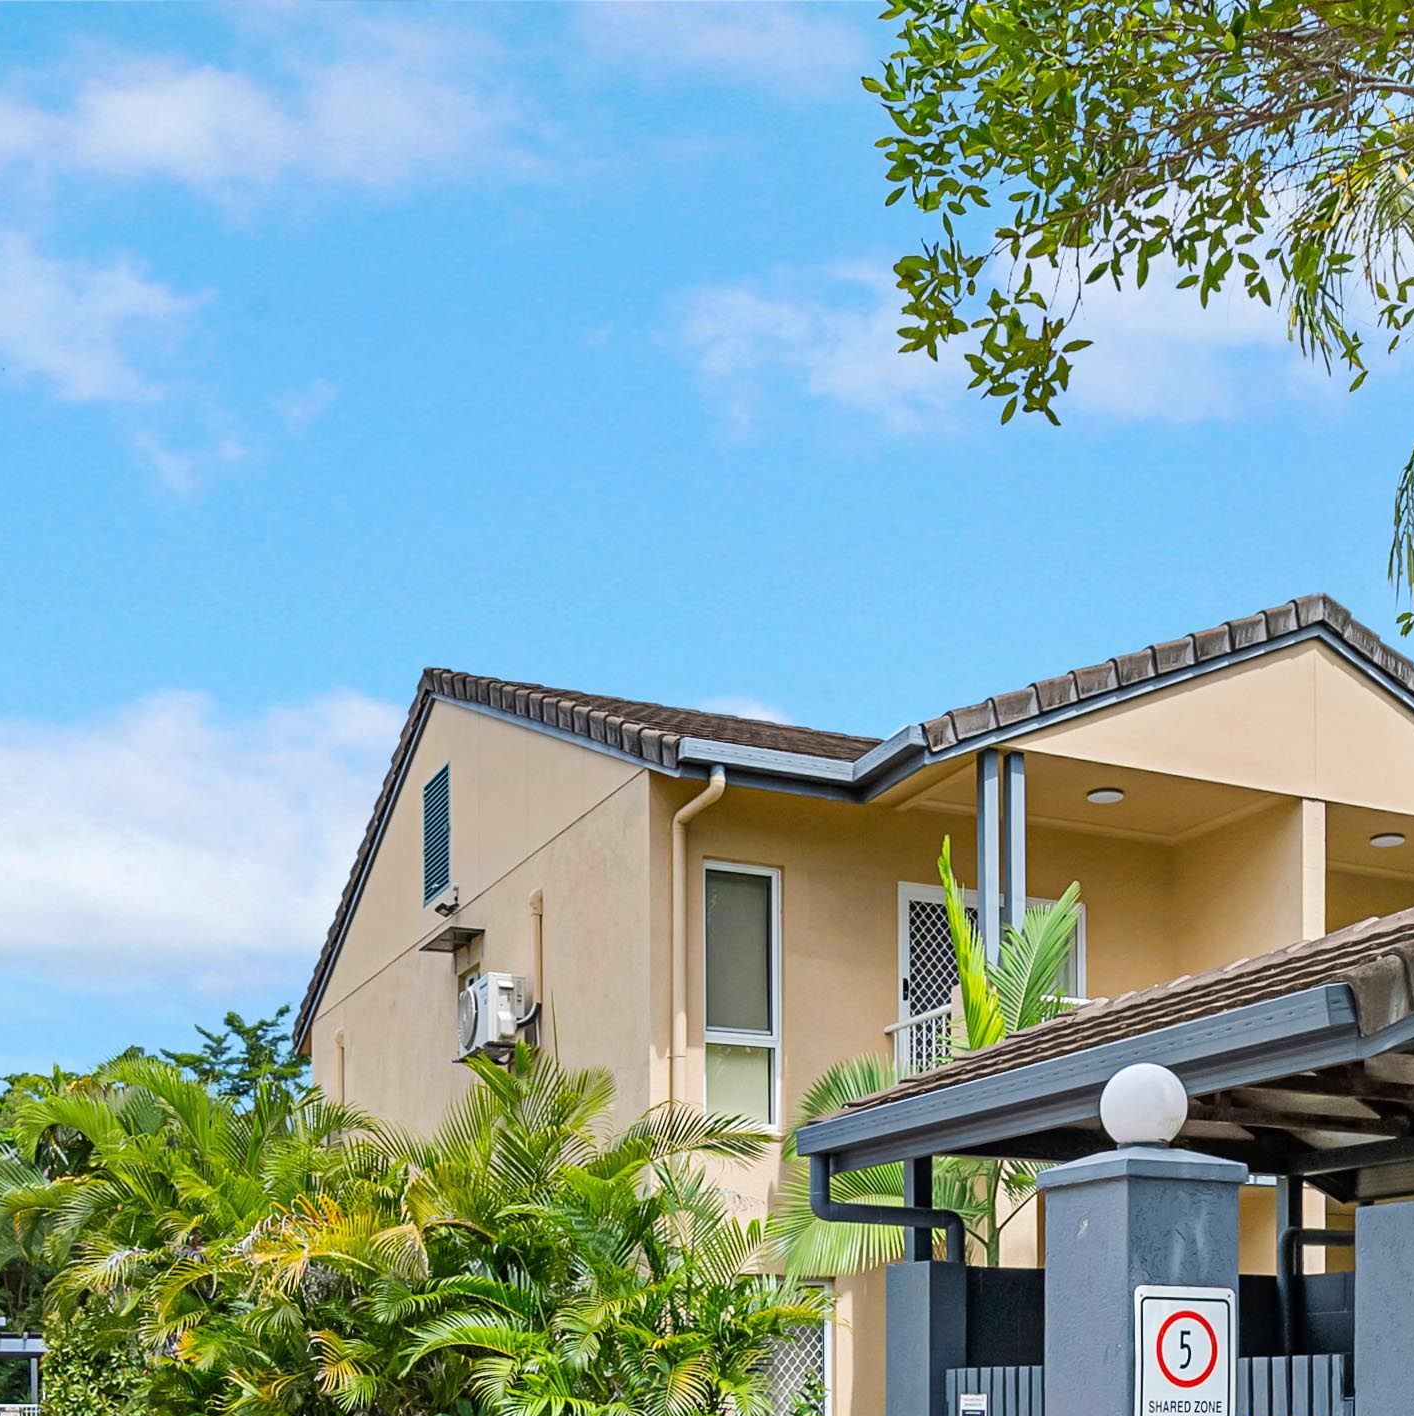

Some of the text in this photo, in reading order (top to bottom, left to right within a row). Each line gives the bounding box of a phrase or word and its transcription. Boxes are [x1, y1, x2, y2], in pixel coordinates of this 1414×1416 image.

[1179, 1330, 1192, 1370] 5
[1148, 1400, 1223, 1414] SHARED ZONE
